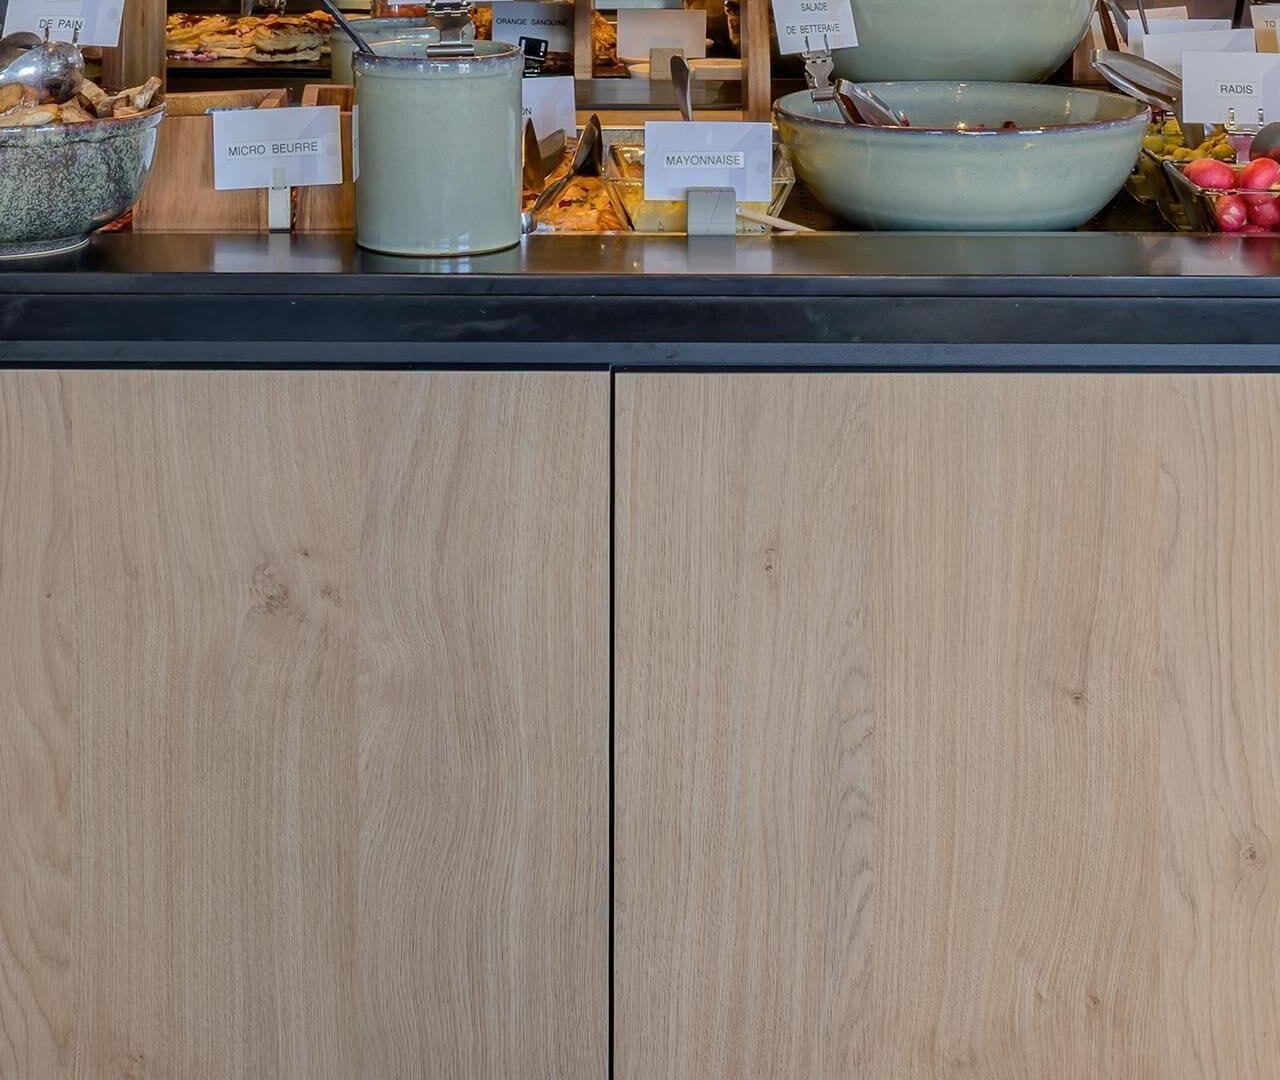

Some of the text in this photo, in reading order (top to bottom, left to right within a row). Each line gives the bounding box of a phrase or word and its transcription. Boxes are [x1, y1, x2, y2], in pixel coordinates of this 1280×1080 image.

[800, 2, 828, 11] SALADE
[39, 19, 83, 29] DE PAIN
[496, 17, 569, 27] ORANGE SANGUINE
[785, 23, 840, 35] DE BETTERAVE
[1220, 84, 1253, 94] RADIS
[228, 141, 319, 157] MICRO BEURRE
[666, 155, 741, 166] MAYONNAISE
